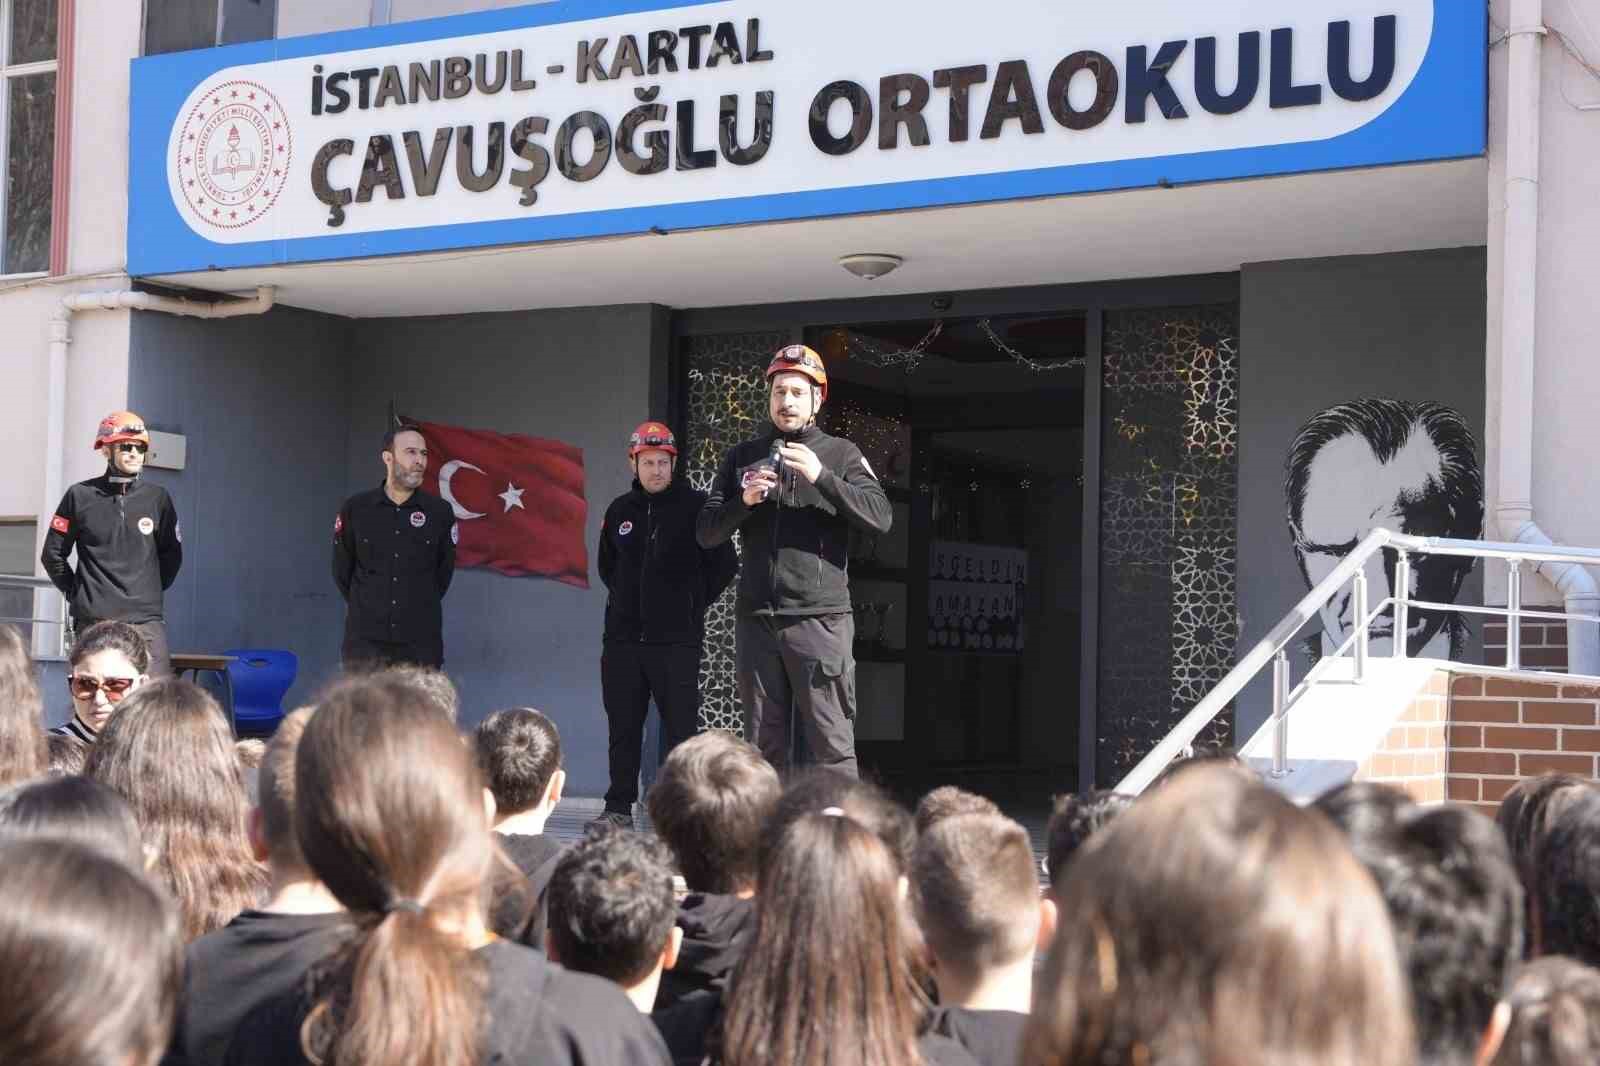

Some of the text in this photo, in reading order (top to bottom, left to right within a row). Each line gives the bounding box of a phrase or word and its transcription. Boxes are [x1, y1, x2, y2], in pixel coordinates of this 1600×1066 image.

[311, 48, 537, 116] İSTANBUL
[576, 17, 775, 84] KARTAL
[310, 14, 1397, 228] ÇAVUŞOĞLU ORTAOKULU
[935, 594, 1015, 615] AMAZAN
